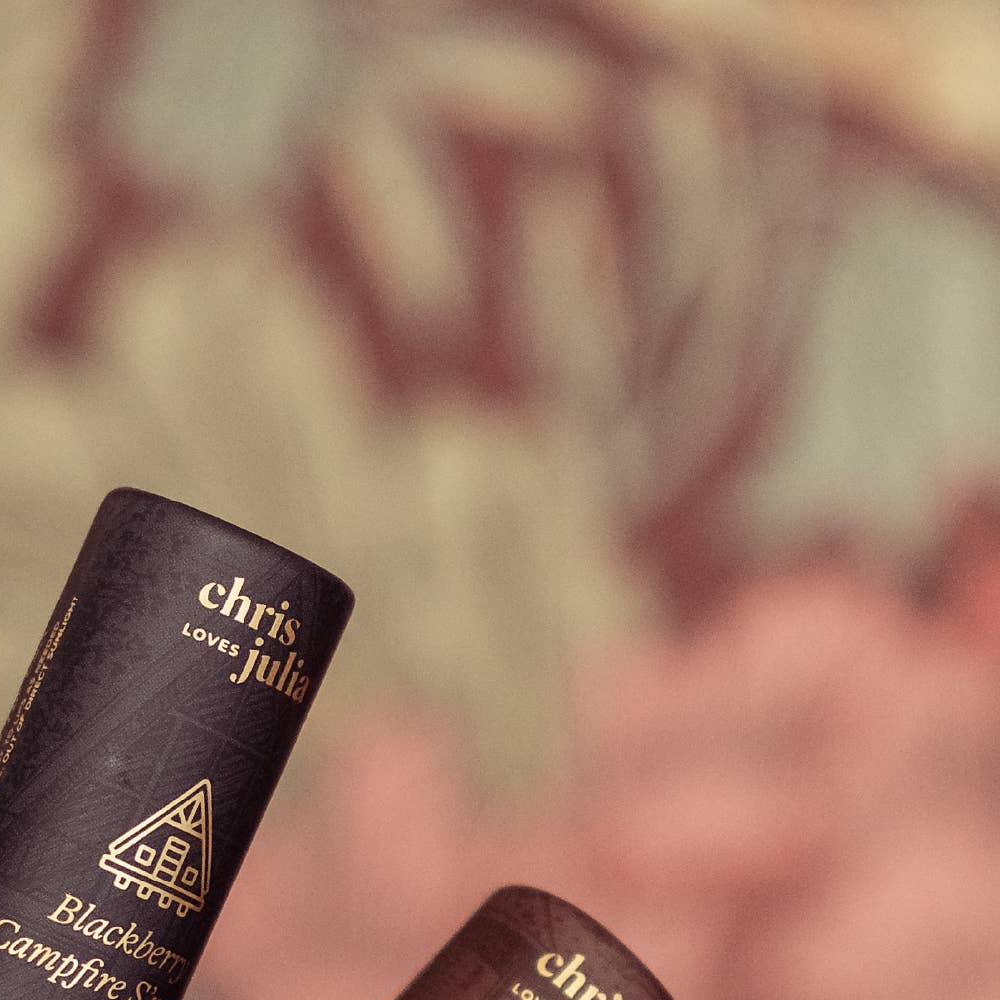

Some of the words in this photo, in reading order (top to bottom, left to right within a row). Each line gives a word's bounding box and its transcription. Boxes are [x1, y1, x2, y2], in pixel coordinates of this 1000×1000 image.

[198, 577, 301, 646] chris
[182, 622, 240, 657] LOVES
[229, 637, 309, 703] julia
[1, 735, 17, 763] OUT
[24, 663, 48, 710] DIRECT
[47, 892, 190, 984] Blackberry
